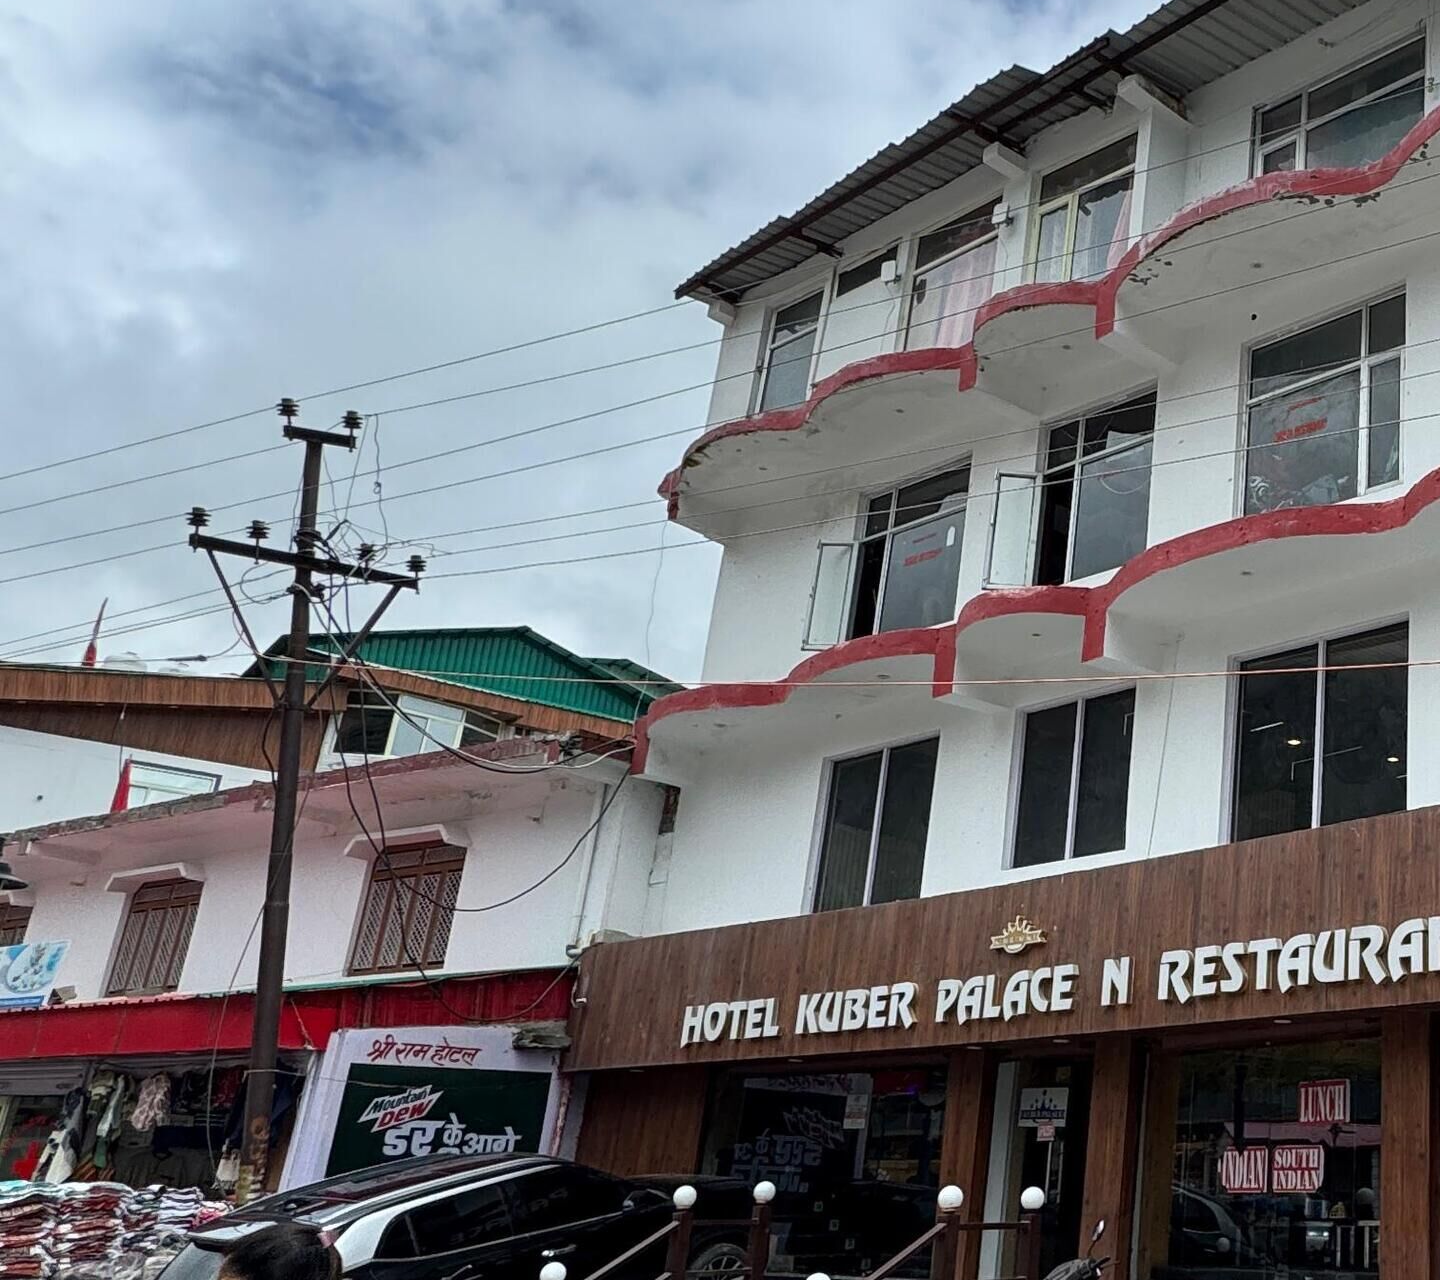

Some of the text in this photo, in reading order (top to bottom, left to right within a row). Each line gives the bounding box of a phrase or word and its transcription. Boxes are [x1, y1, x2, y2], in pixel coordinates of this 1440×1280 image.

[680, 997, 779, 1048] HOTEL
[795, 981, 918, 1034] KUBER
[935, 964, 1079, 1025] PALACE
[1101, 956, 1135, 1007] N
[367, 1034, 482, 1066] श्री राम होटल
[366, 1088, 429, 1115] Mountain
[1300, 1084, 1345, 1123] LUNCH
[382, 1120, 446, 1157] डर
[442, 1112, 467, 1146] के
[1222, 1150, 1266, 1190] INDIAN
[1273, 1148, 1320, 1169] SOUTH
[1272, 1170, 1321, 1190] INDIAN
